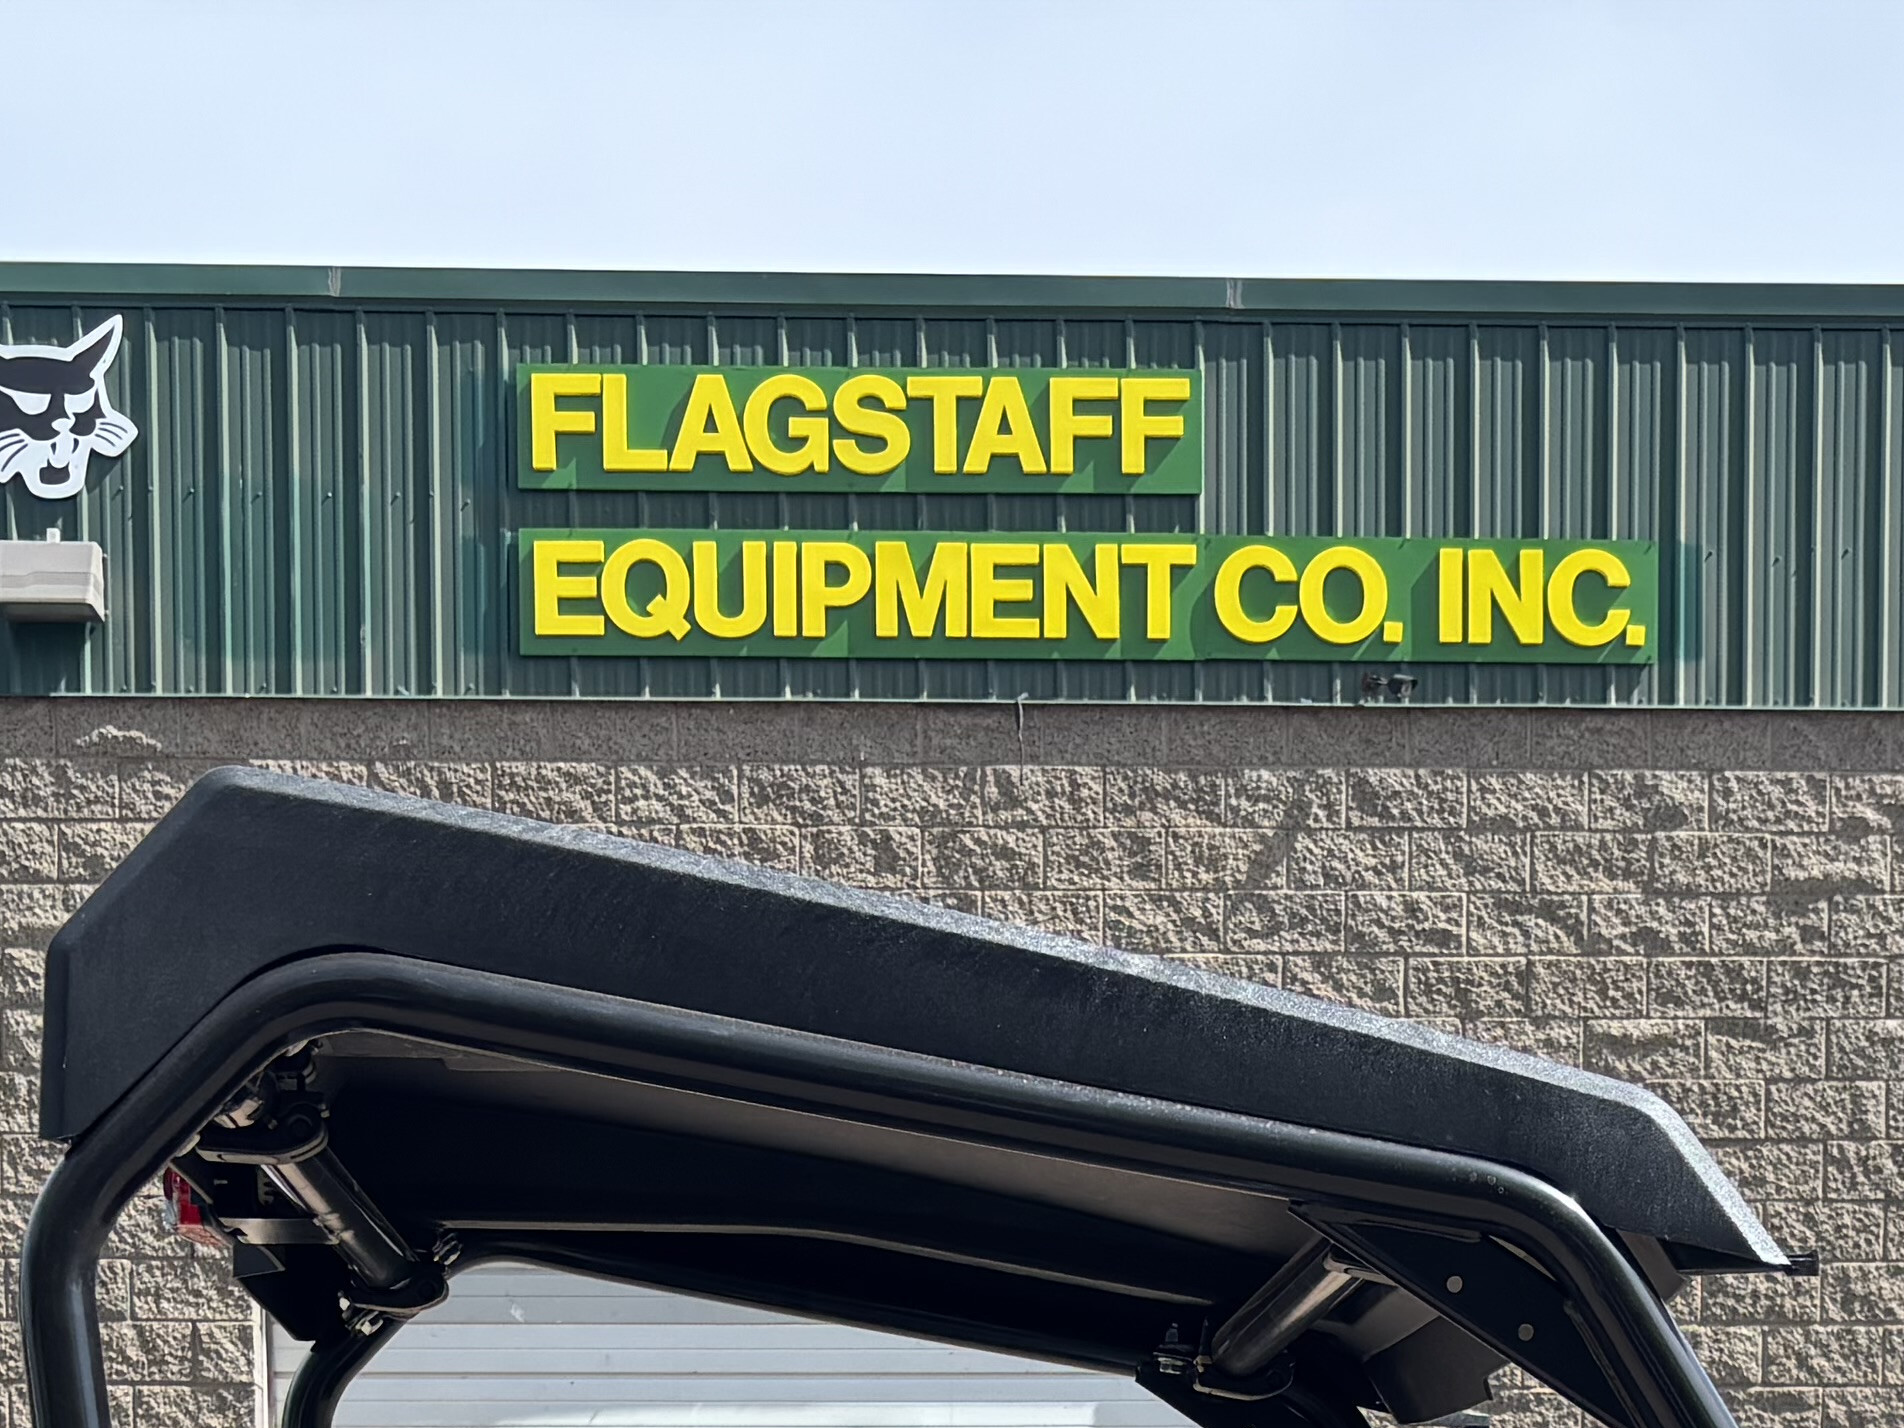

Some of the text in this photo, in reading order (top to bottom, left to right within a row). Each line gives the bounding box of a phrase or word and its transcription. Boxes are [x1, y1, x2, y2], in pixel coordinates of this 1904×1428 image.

[530, 372, 1191, 476] FLAGSTAFF
[533, 539, 1647, 649] EQUIPMENT CO. INC.
